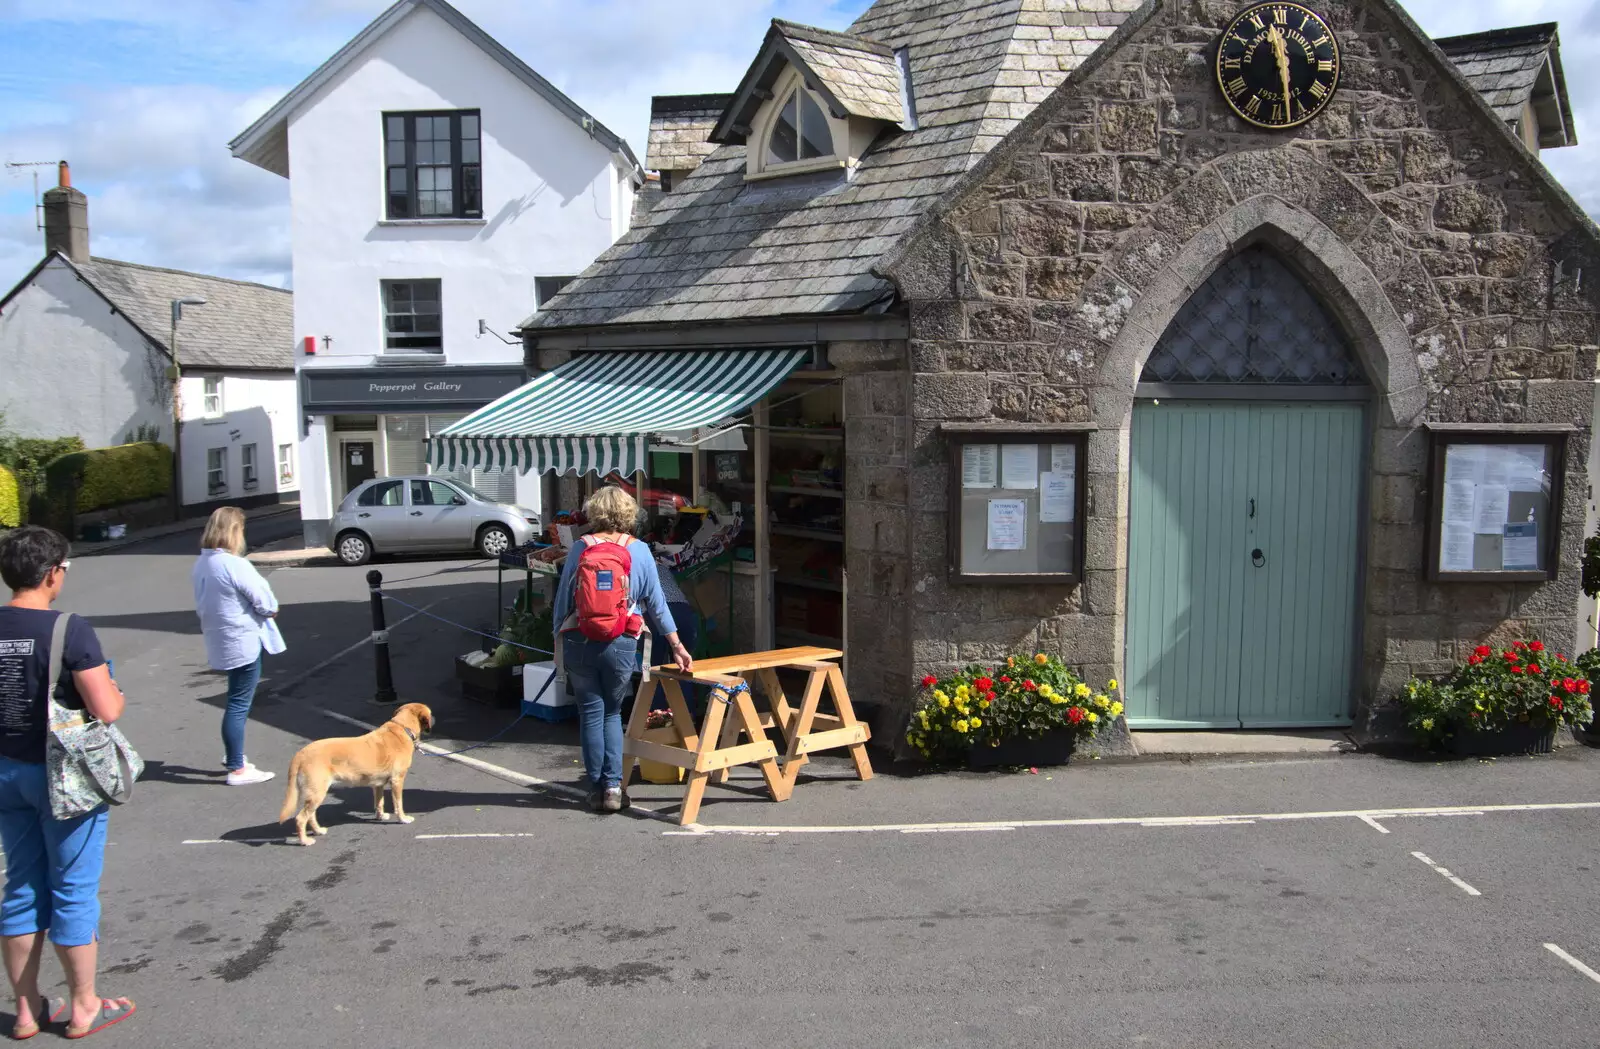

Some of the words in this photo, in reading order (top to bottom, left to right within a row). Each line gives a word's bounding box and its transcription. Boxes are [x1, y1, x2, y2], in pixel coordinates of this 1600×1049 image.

[1249, 14, 1265, 31] XI
[1273, 9, 1288, 25] XII
[1299, 16, 1309, 31] I
[1232, 33, 1248, 46] X
[1243, 27, 1286, 64] DIAMOD
[1285, 27, 1316, 65] JUBILEE
[1312, 35, 1329, 48] II
[1317, 59, 1333, 73] III
[1257, 87, 1302, 101] 1952-212
[369, 383, 416, 392] Pepperpot
[424, 382, 461, 392] Gallery
